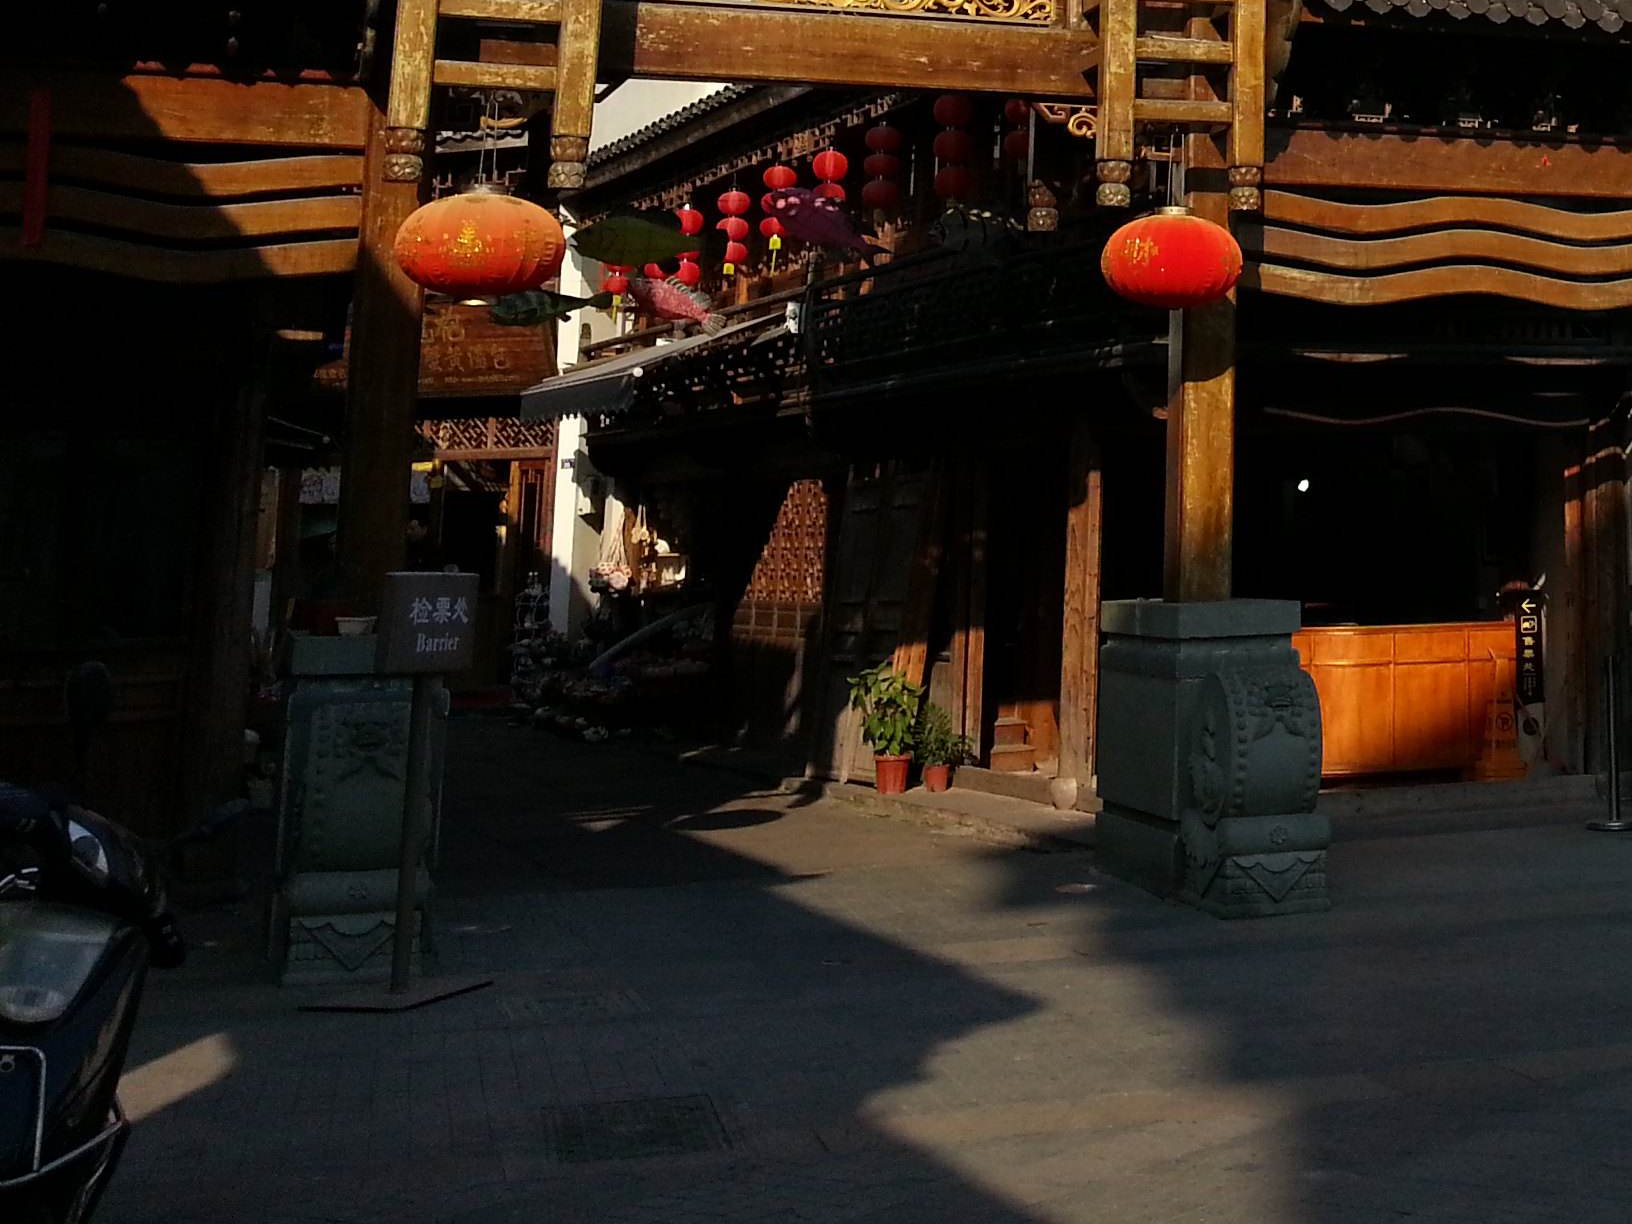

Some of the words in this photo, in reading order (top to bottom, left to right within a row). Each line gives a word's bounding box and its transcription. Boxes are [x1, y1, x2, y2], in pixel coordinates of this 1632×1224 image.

[409, 596, 469, 626] 检票处
[416, 632, 460, 652] Barrier
